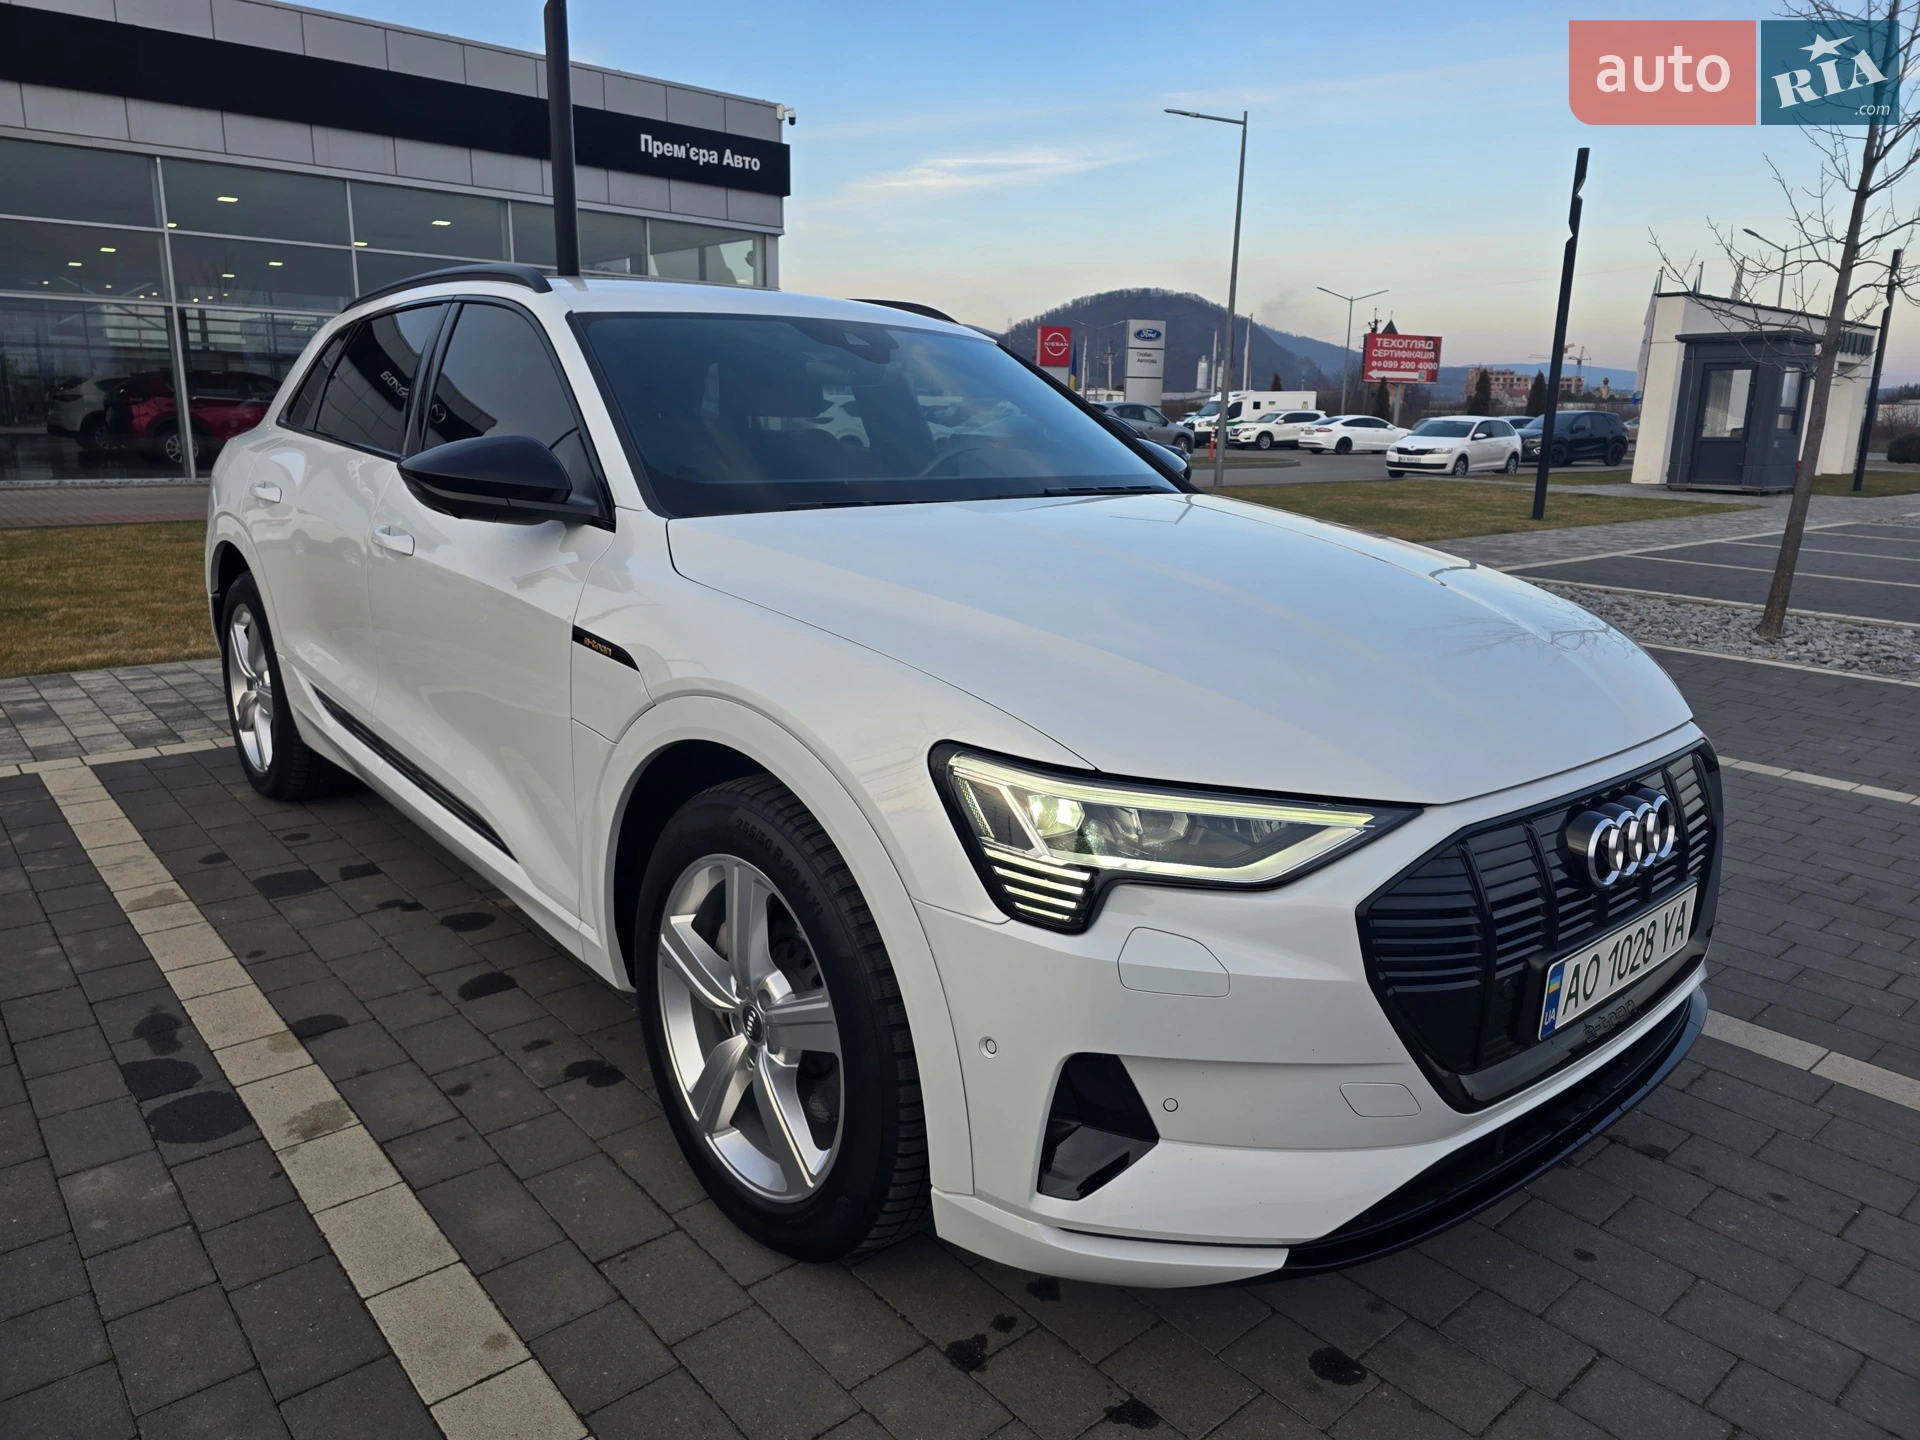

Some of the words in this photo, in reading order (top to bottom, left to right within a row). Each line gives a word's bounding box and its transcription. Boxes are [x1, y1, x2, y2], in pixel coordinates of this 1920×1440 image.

[722, 148, 761, 171] Авто
[1140, 328, 1158, 338] Ford
[1376, 338, 1434, 349] ТЕХОГЛЯД
[1371, 348, 1435, 360] СЕРТИФІКАЦІЯ
[1383, 360, 1399, 369] 099
[1400, 361, 1416, 369] 200
[1418, 362, 1438, 370] 4000
[735, 818, 773, 851] 255/50
[774, 845, 784, 862] R
[783, 860, 800, 880] 20
[1561, 953, 1601, 1017] AO
[1608, 919, 1657, 987] 1028
[1663, 900, 1687, 954] YA
[1544, 1007, 1556, 1026] UA
[1583, 999, 1638, 1043] e-tron
